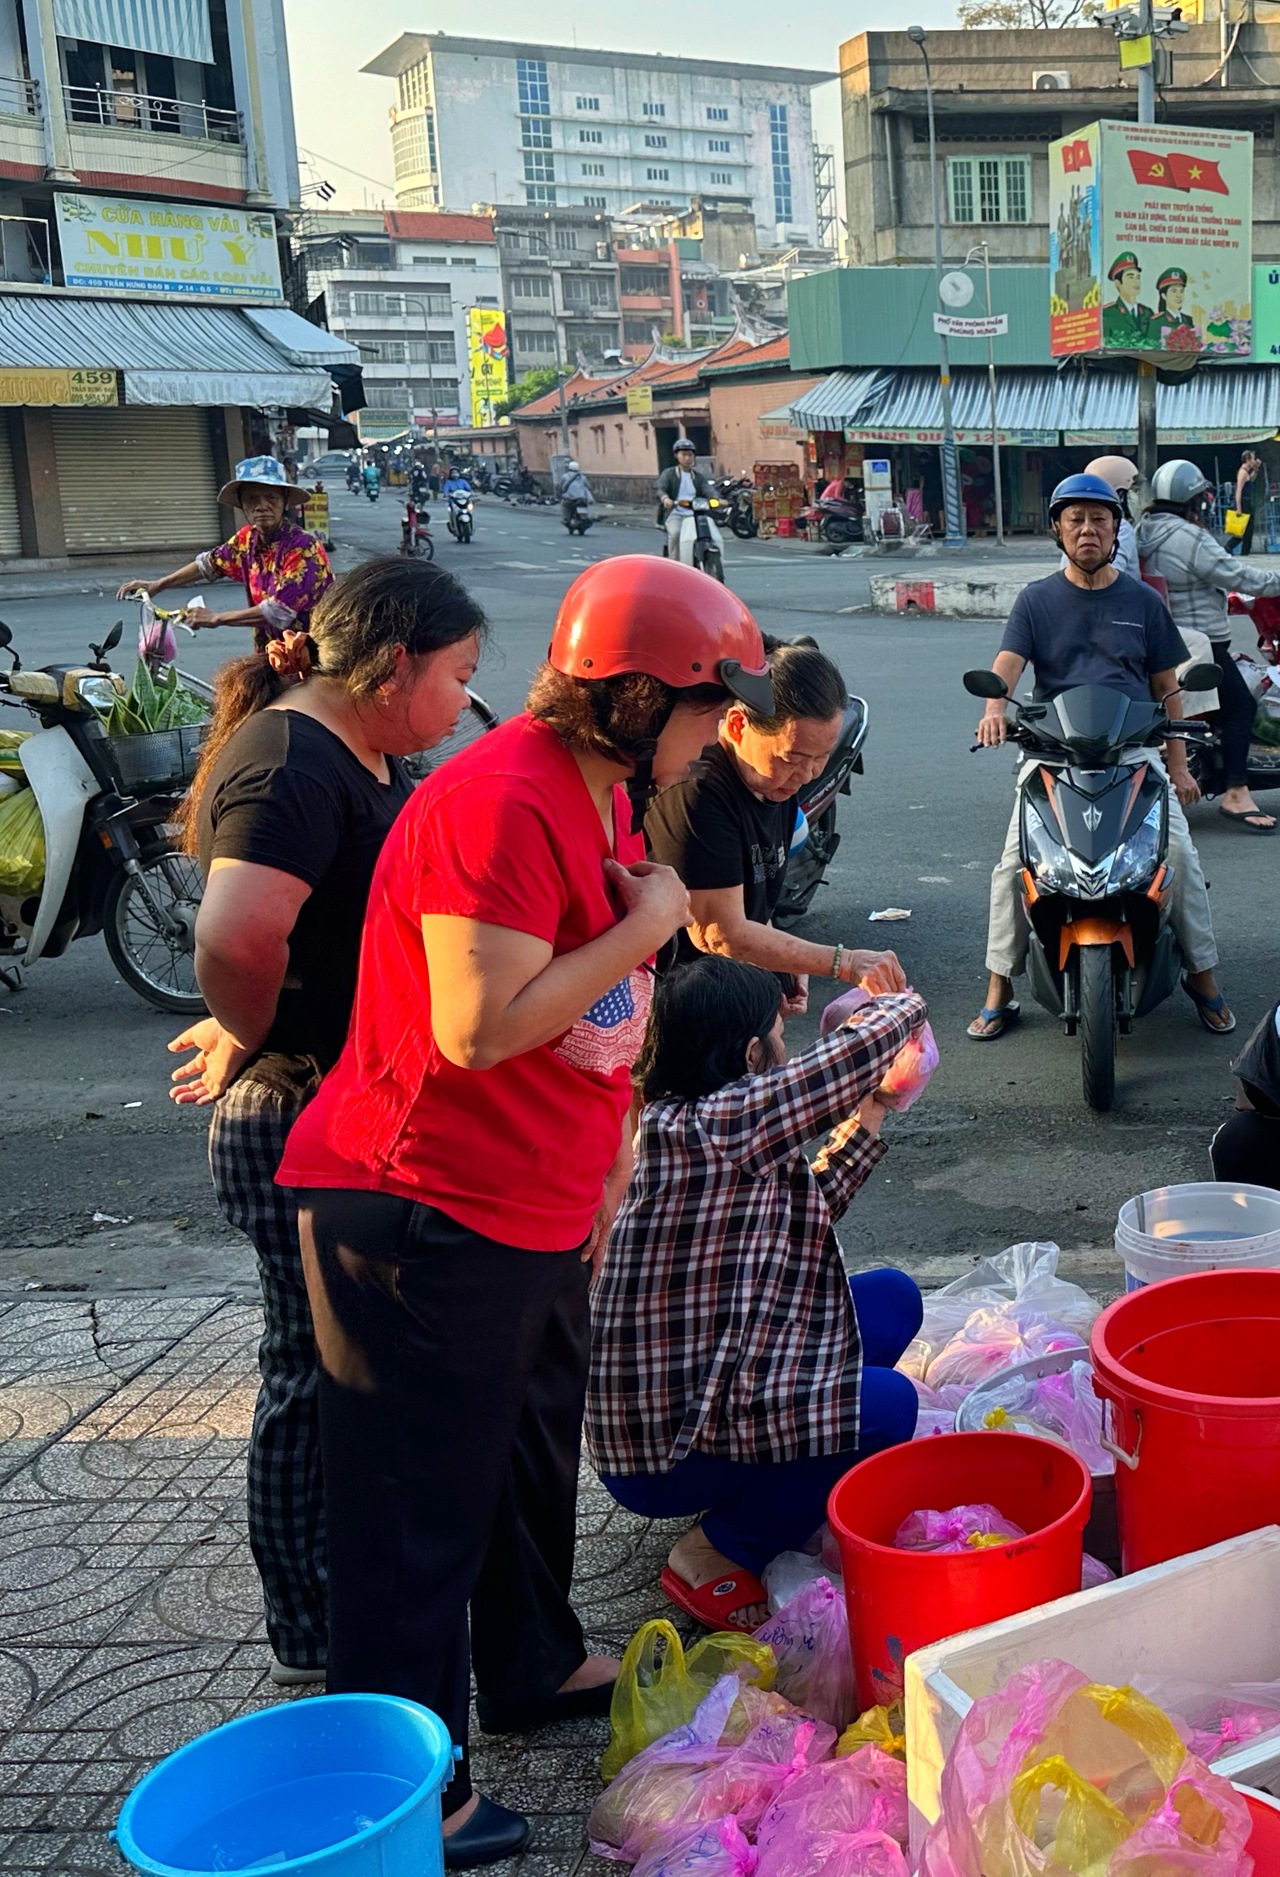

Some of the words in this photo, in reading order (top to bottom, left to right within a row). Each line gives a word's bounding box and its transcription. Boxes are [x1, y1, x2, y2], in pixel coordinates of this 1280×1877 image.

[102, 205, 143, 225] CỬA
[150, 208, 203, 230] HÀNG
[208, 213, 239, 232] VẢI
[85, 229, 208, 265] NHƯ
[220, 234, 257, 267] Ý
[74, 262, 138, 277] CHUYÊN
[143, 265, 175, 279] BÁN
[180, 267, 209, 281] CÁC
[71, 371, 113, 385] 459
[916, 430, 965, 442] QUY
